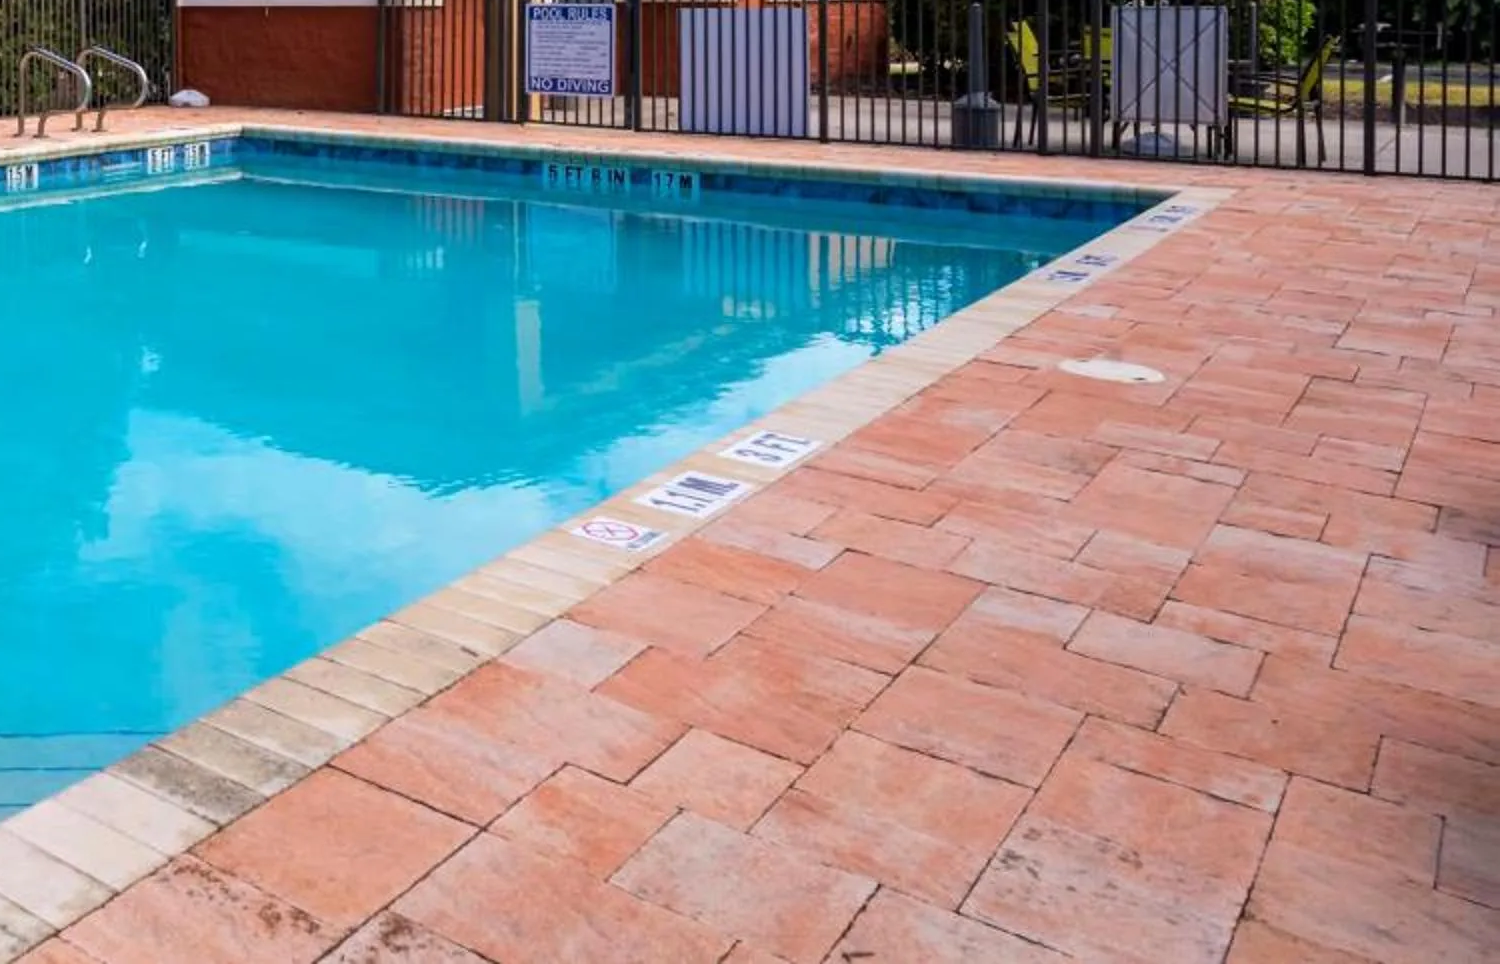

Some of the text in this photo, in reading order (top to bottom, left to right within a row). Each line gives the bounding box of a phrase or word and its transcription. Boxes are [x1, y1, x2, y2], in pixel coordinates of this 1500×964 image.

[533, 7, 607, 21] POOL RULES
[531, 77, 609, 92] NO DIVING
[548, 164, 558, 181] 5
[565, 165, 582, 182] FT
[607, 168, 625, 184] IN
[751, 433, 810, 453] FT
